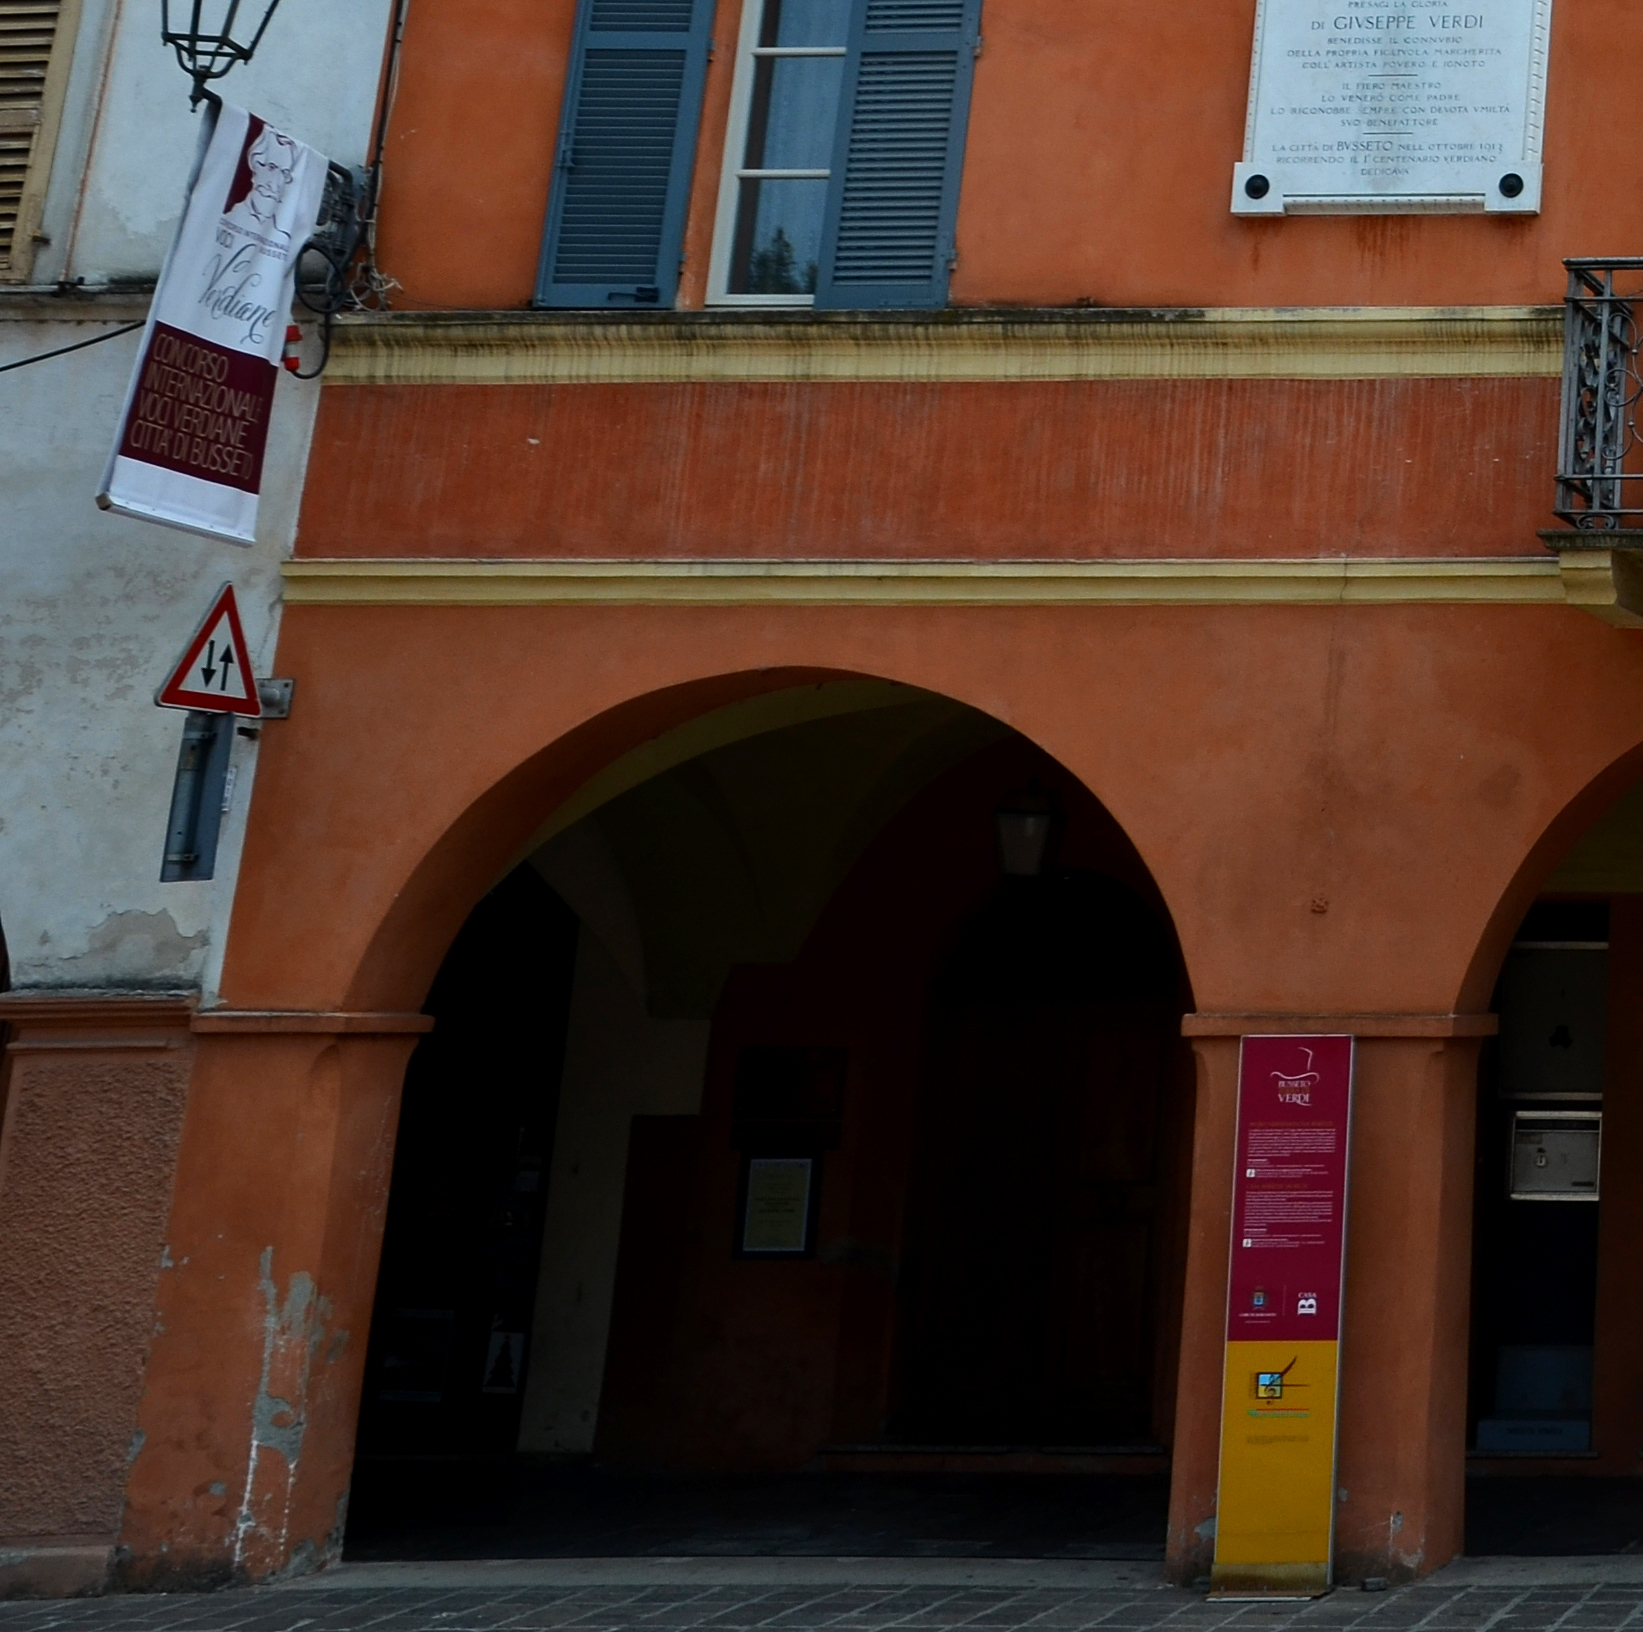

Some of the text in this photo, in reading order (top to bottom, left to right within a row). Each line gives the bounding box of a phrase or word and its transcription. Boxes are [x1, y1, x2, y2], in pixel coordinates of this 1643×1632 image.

[1411, 0, 1448, 8] GLORIA
[1311, 15, 1484, 30] DI GIVSEPPE VERDI
[1287, 49, 1320, 57] DELLA
[1325, 49, 1368, 57] PROPRIA
[1434, 48, 1501, 56] MARGHERITA
[1382, 60, 1425, 68] POVERO
[1443, 60, 1485, 68] IGNOTO
[1342, 82, 1351, 90] IL
[1356, 82, 1384, 90] FIERO
[1389, 94, 1420, 102] COME
[1290, 107, 1351, 115] RICONOBBE
[1402, 106, 1425, 114] CON
[1366, 118, 1438, 126] BENEFATTORE
[1272, 144, 1285, 152] LA
[1336, 140, 1393, 152] BVSSETO
[1428, 143, 1473, 151] OTTOBRE
[1479, 143, 1503, 154] 1913
[1276, 156, 1345, 164] RICORRENDO
[1372, 155, 1440, 163] CENTENARIO
[1443, 155, 1497, 164] VERDIANO
[1360, 168, 1409, 176] DEDICAVA
[198, 243, 277, 344] Verdiane
[153, 333, 229, 382] CONCORSO
[138, 390, 250, 448] VOCI VERDIANE
[173, 433, 189, 461] DI
[1278, 1093, 1311, 1105] VERDI
